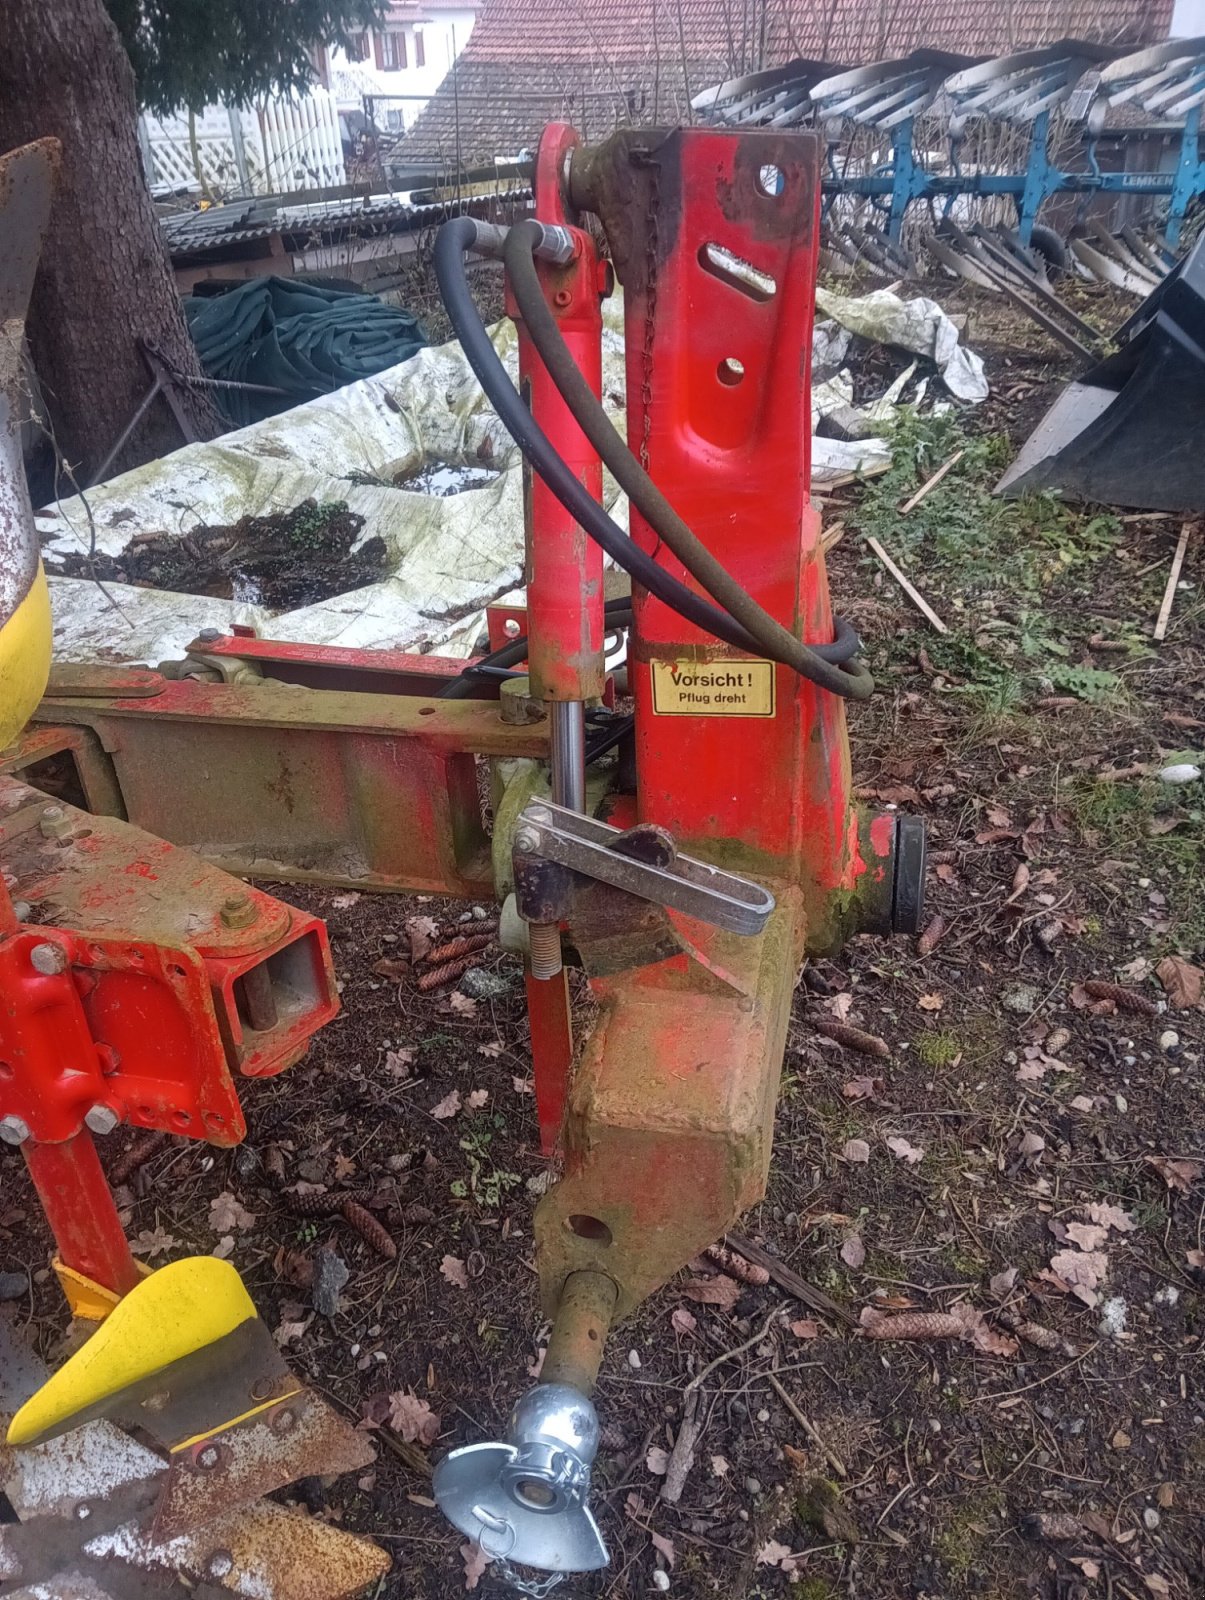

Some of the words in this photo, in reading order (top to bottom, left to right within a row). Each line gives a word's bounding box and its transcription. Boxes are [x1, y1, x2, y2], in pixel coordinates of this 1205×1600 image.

[1122, 175, 1174, 186] LEMKEN
[679, 692, 710, 704] Pflug
[714, 693, 746, 703] dreht
